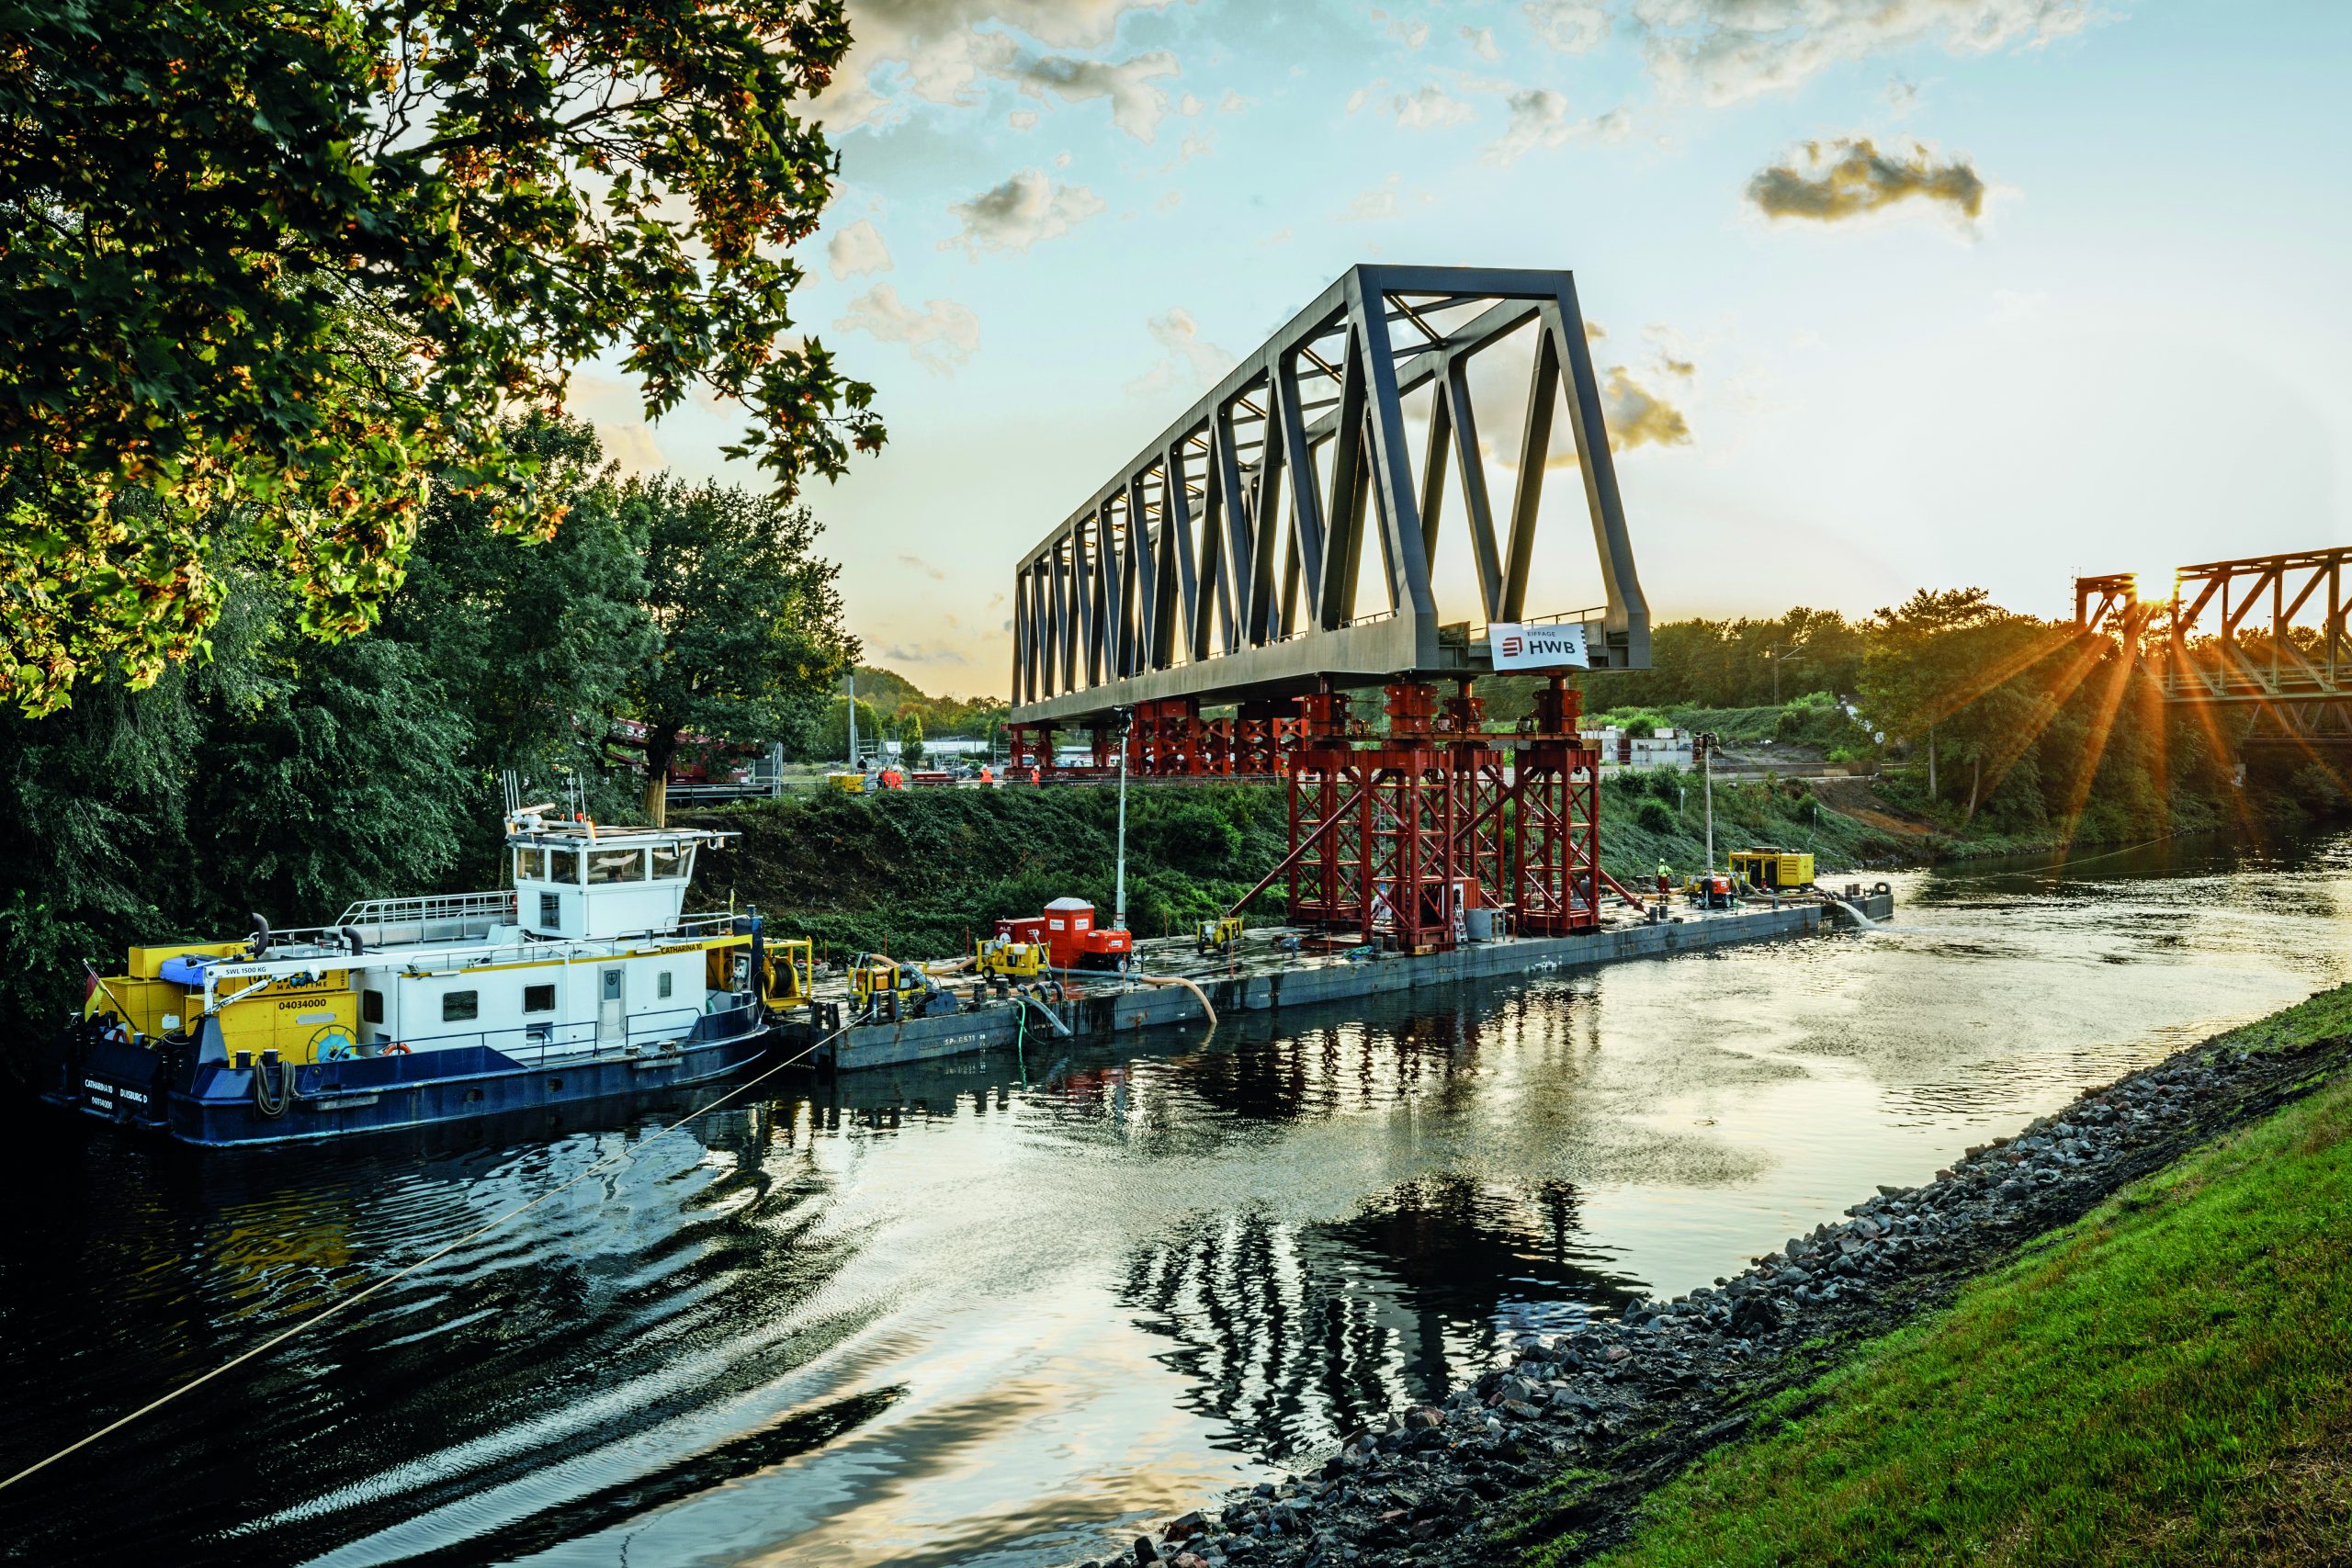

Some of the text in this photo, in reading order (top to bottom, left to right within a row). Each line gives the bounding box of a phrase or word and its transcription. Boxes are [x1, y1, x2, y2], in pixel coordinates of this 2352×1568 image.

[1529, 640, 1576, 655] HWB
[662, 944, 695, 953] CATHARINA
[278, 998, 326, 1010] 04034000
[85, 1078, 107, 1093] CATHARINA
[119, 1089, 142, 1102] DUISBURG
